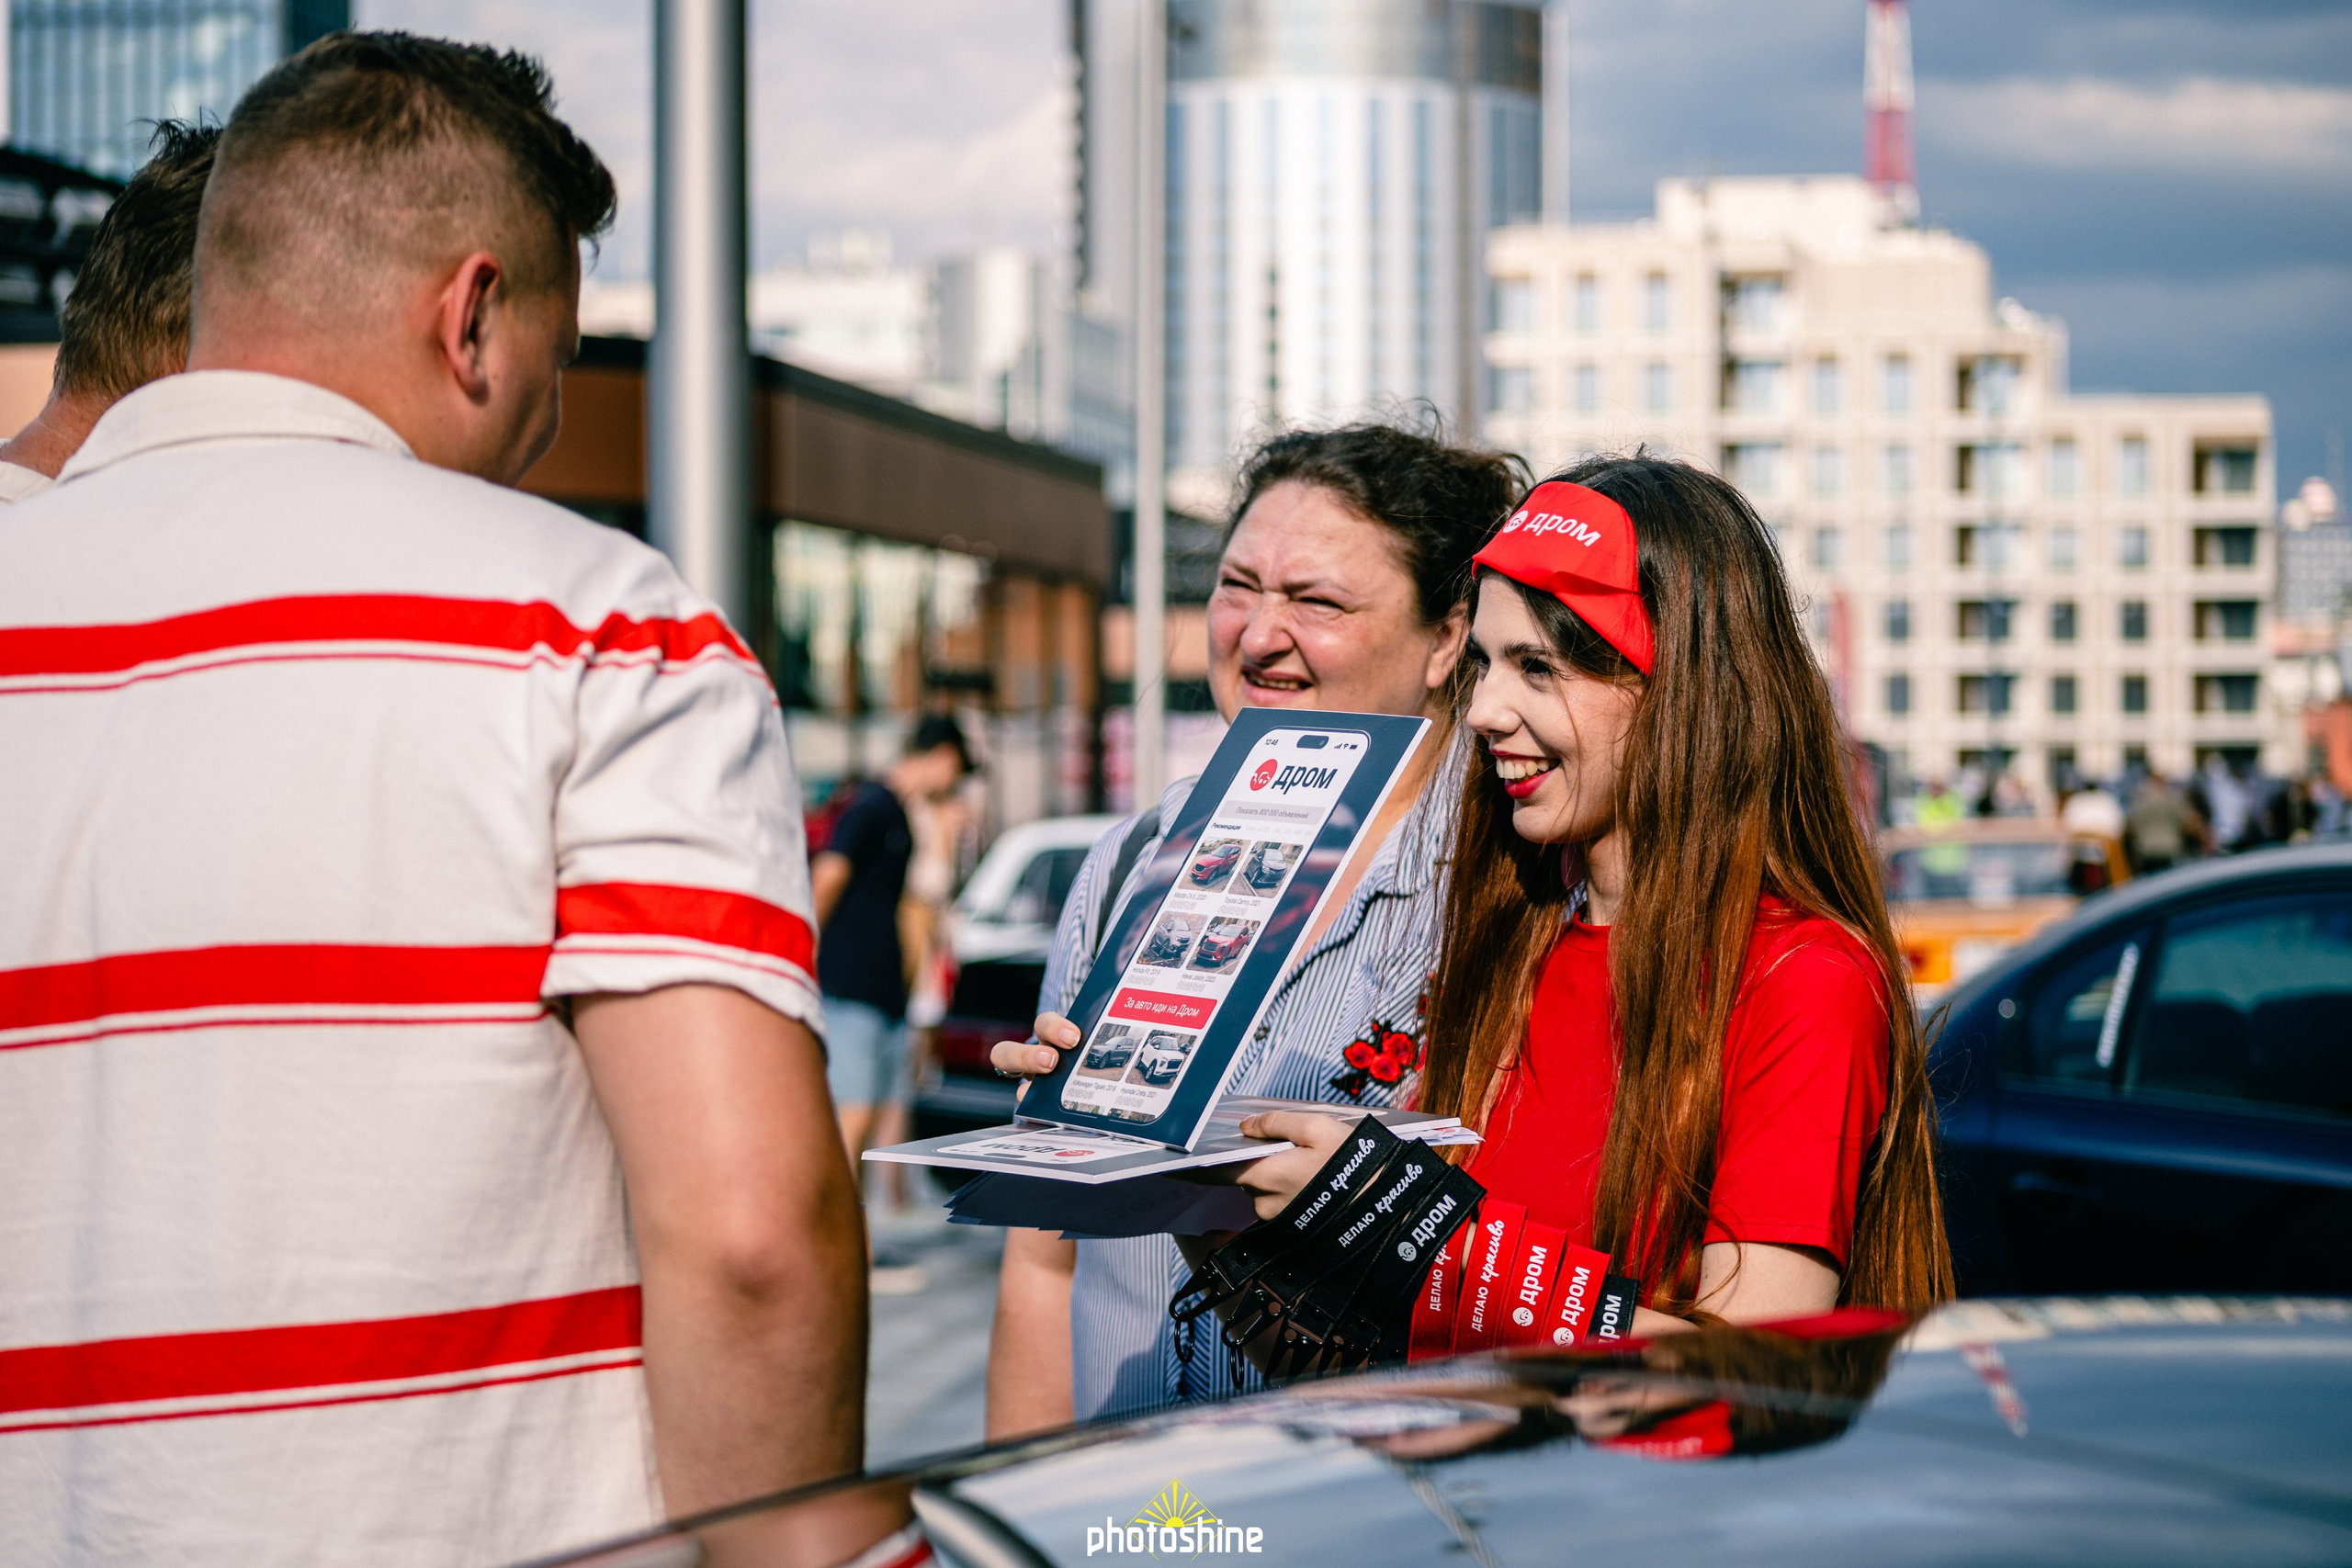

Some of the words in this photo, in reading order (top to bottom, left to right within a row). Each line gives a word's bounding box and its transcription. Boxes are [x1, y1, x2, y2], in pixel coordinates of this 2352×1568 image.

[1522, 513, 1601, 547] дром
[1271, 765, 1338, 795] дром
[1235, 807, 1258, 816] Показать
[1259, 808, 1268, 817] 800
[1278, 810, 1309, 819] объявлений
[1125, 997, 1135, 1008] За
[1134, 1000, 1152, 1010] авто
[1151, 1003, 1168, 1013] иди
[1167, 1005, 1178, 1014] на
[1175, 1004, 1200, 1017] Дром
[1295, 1190, 1332, 1230] ДЕЛАЮ
[1329, 1138, 1376, 1191] красиво
[1338, 1212, 1375, 1247] ДЕЛАЮ
[1374, 1163, 1423, 1213] красиво
[1410, 1193, 1458, 1247] дром
[1479, 1219, 1505, 1283] красиво
[1520, 1245, 1548, 1306] дром
[1430, 1269, 1443, 1312] ДЕЛАЮ
[1471, 1286, 1489, 1333] ДЕЛАЮ
[1561, 1266, 1590, 1325] дром
[1599, 1294, 1623, 1343] ром
